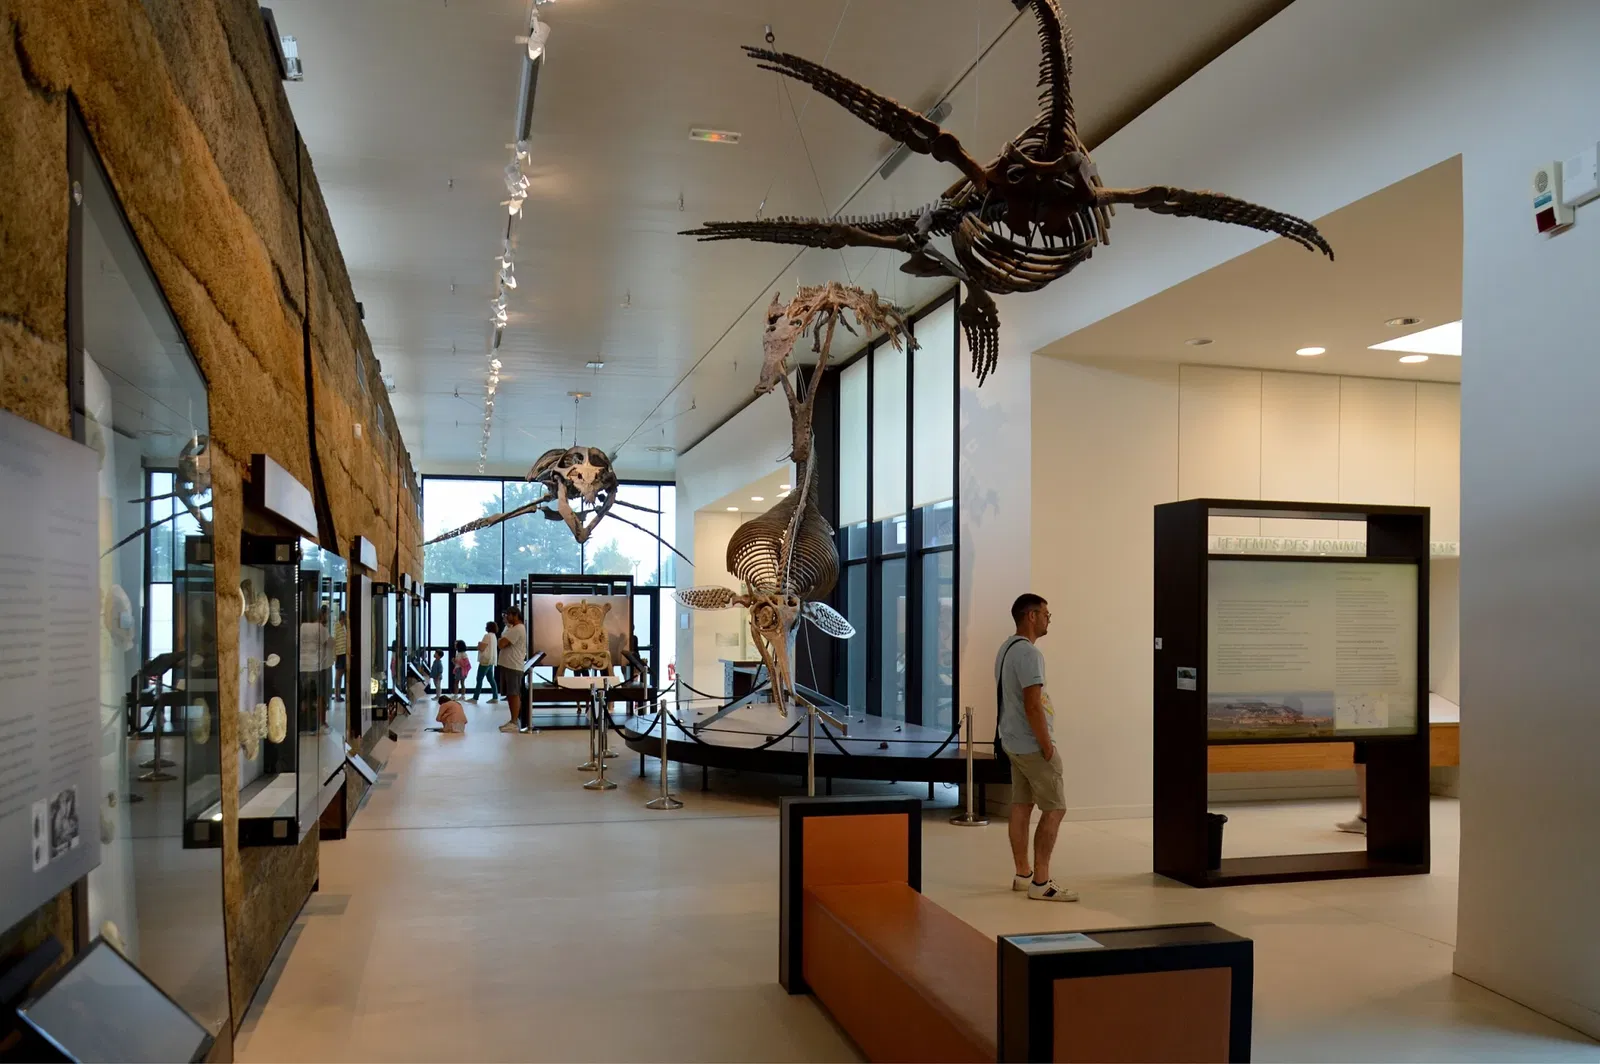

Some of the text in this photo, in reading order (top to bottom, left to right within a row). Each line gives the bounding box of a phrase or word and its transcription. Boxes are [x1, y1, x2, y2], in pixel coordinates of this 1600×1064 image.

[1217, 537, 1233, 549] LE
[1236, 537, 1280, 550] TEMPS
[1284, 538, 1309, 551] DES
